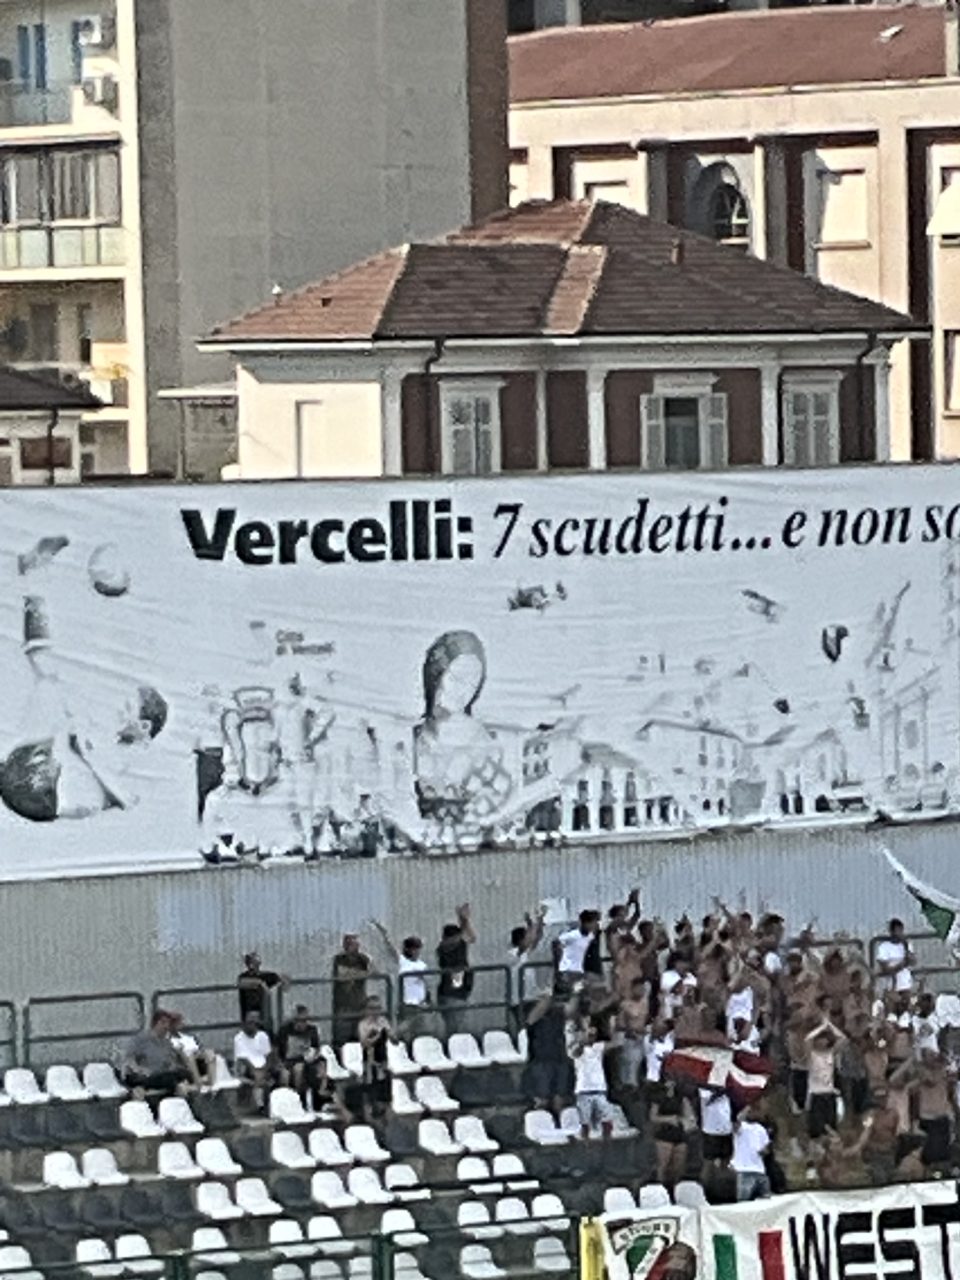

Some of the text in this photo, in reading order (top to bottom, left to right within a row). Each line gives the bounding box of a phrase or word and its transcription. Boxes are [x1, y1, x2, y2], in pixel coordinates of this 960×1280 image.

[180, 499, 474, 564] Vercelli:
[492, 503, 523, 558] 7
[528, 496, 772, 557] scudetti...
[781, 509, 807, 548] e
[816, 504, 912, 547] non
